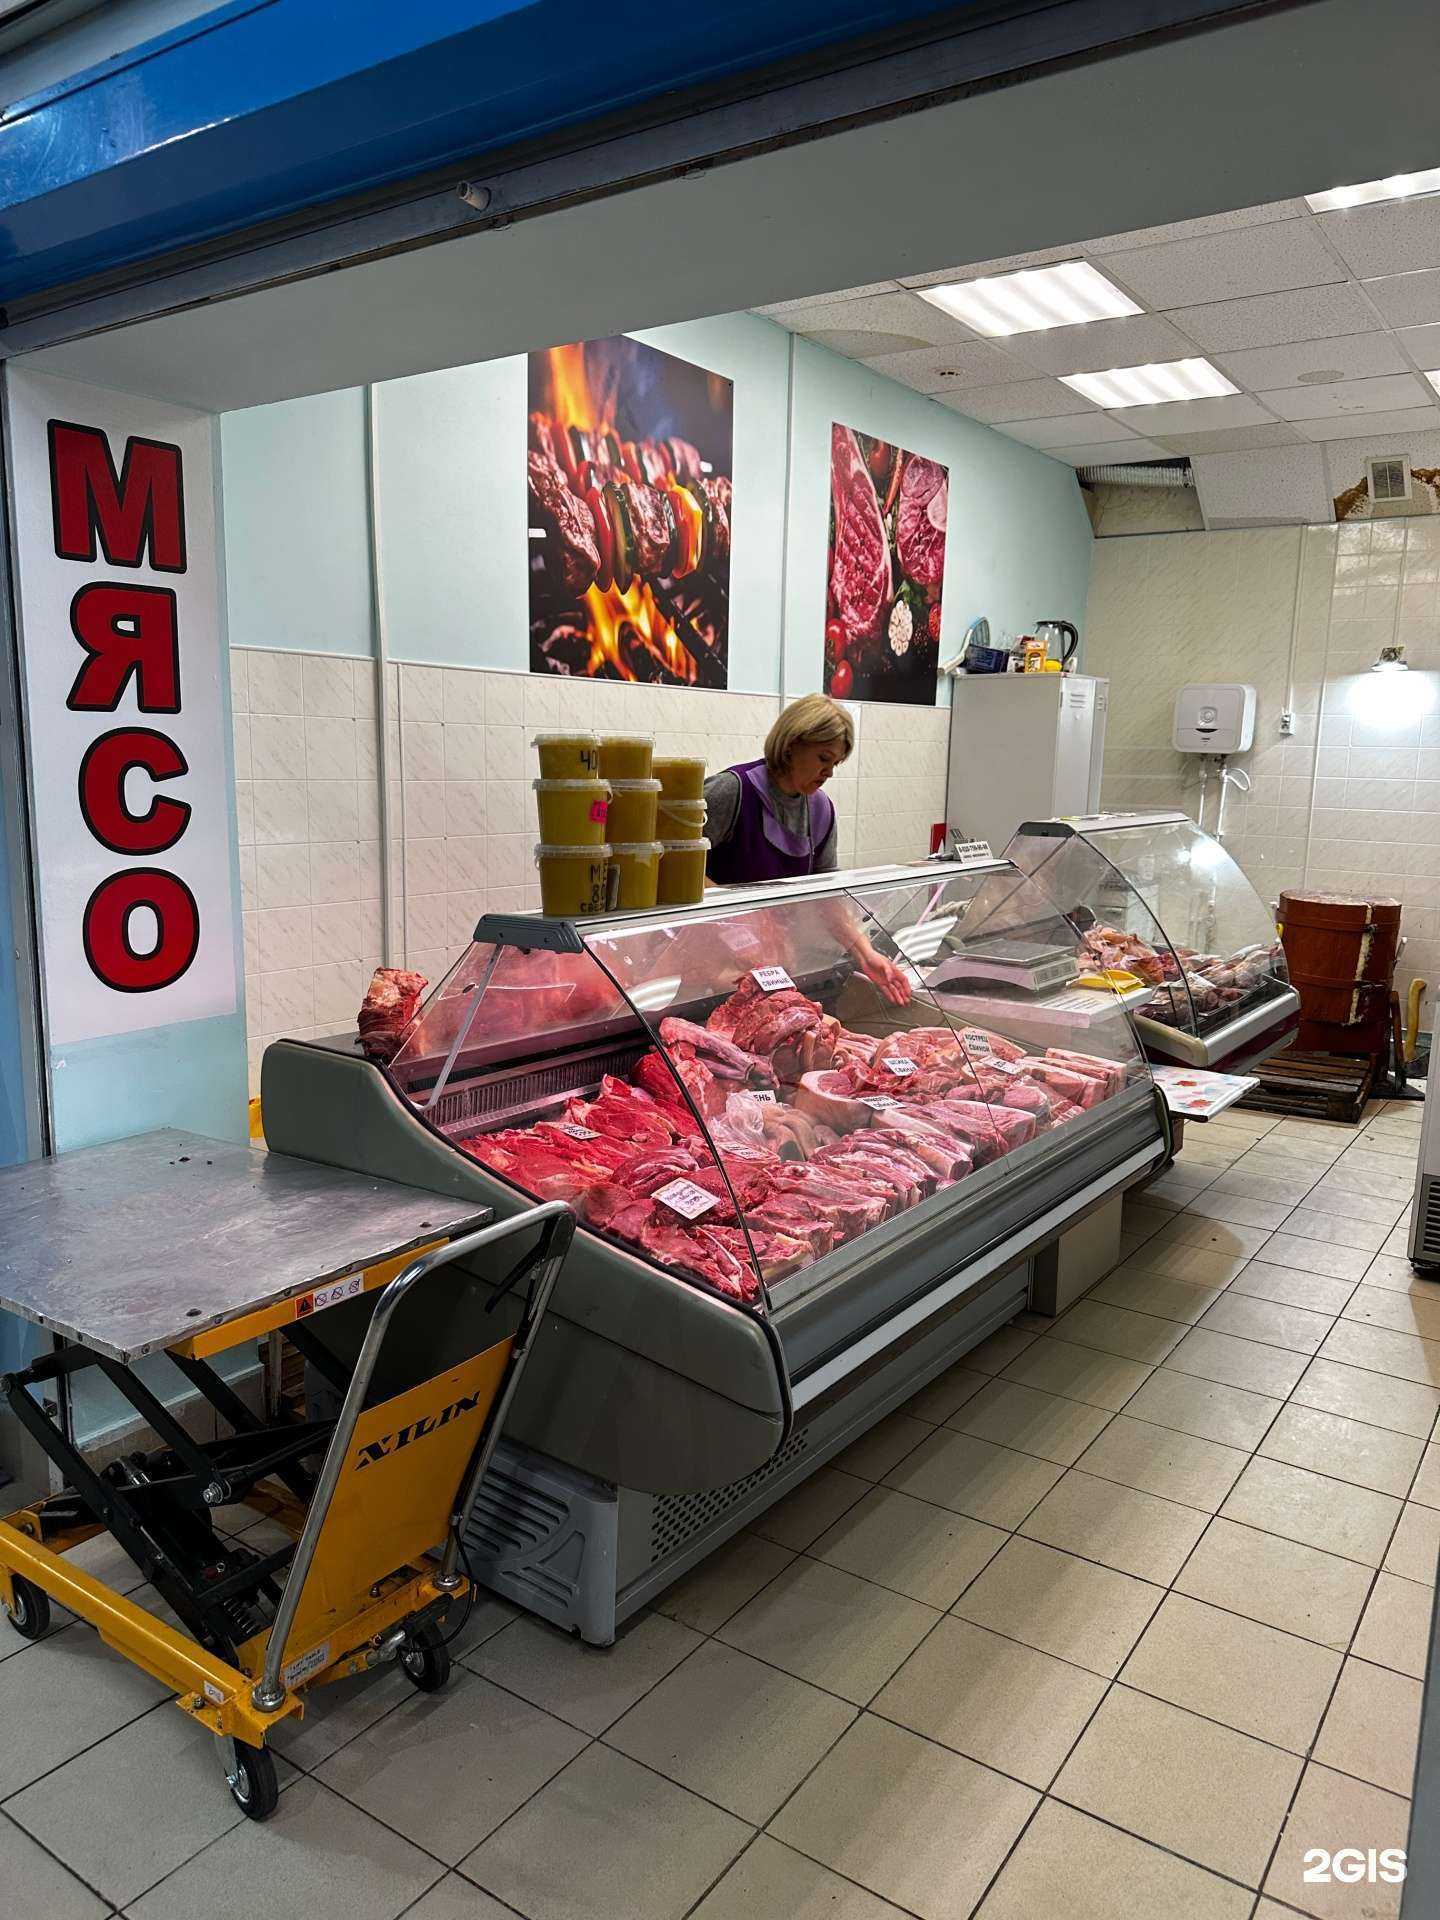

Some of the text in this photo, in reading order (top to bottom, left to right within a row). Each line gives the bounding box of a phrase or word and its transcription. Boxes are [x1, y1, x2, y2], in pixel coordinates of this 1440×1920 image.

[47, 418, 200, 994] МЯСО
[758, 970, 780, 978] РЕБРА
[762, 977, 790, 987] СВИНЫЕ
[354, 1390, 481, 1472] XILIN
